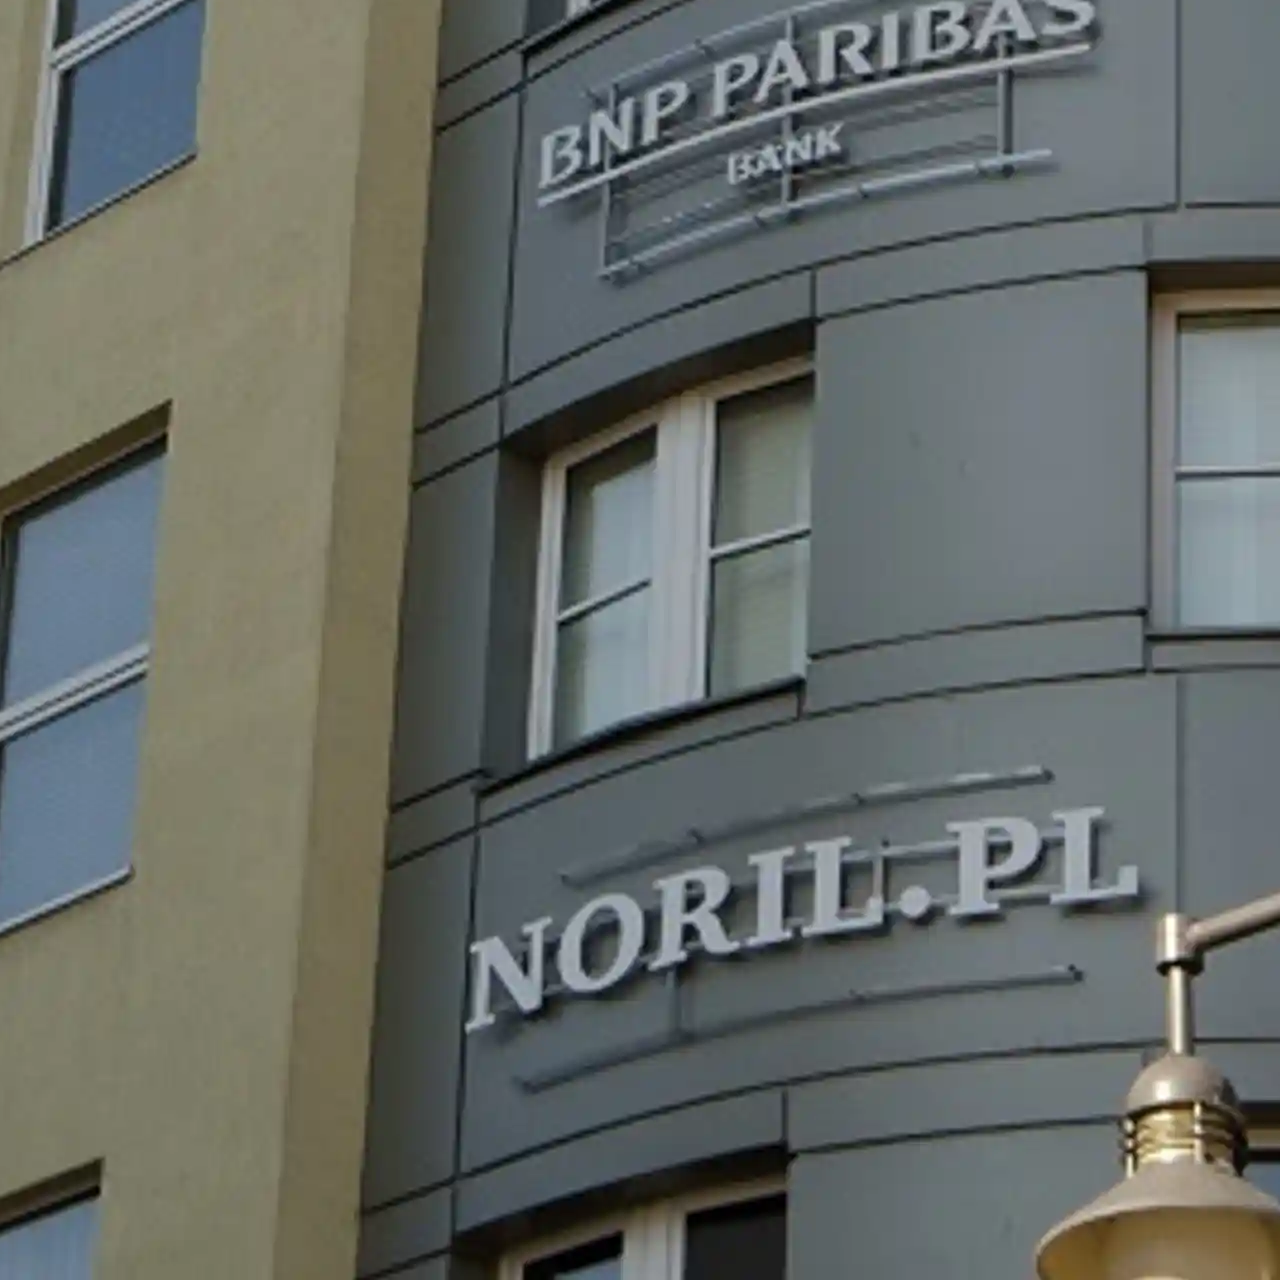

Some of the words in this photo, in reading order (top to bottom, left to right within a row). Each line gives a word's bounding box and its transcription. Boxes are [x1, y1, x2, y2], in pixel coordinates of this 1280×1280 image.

[537, 80, 688, 190] BNP
[726, 122, 844, 186] BANK
[465, 804, 1140, 1034] NORIL.PL
